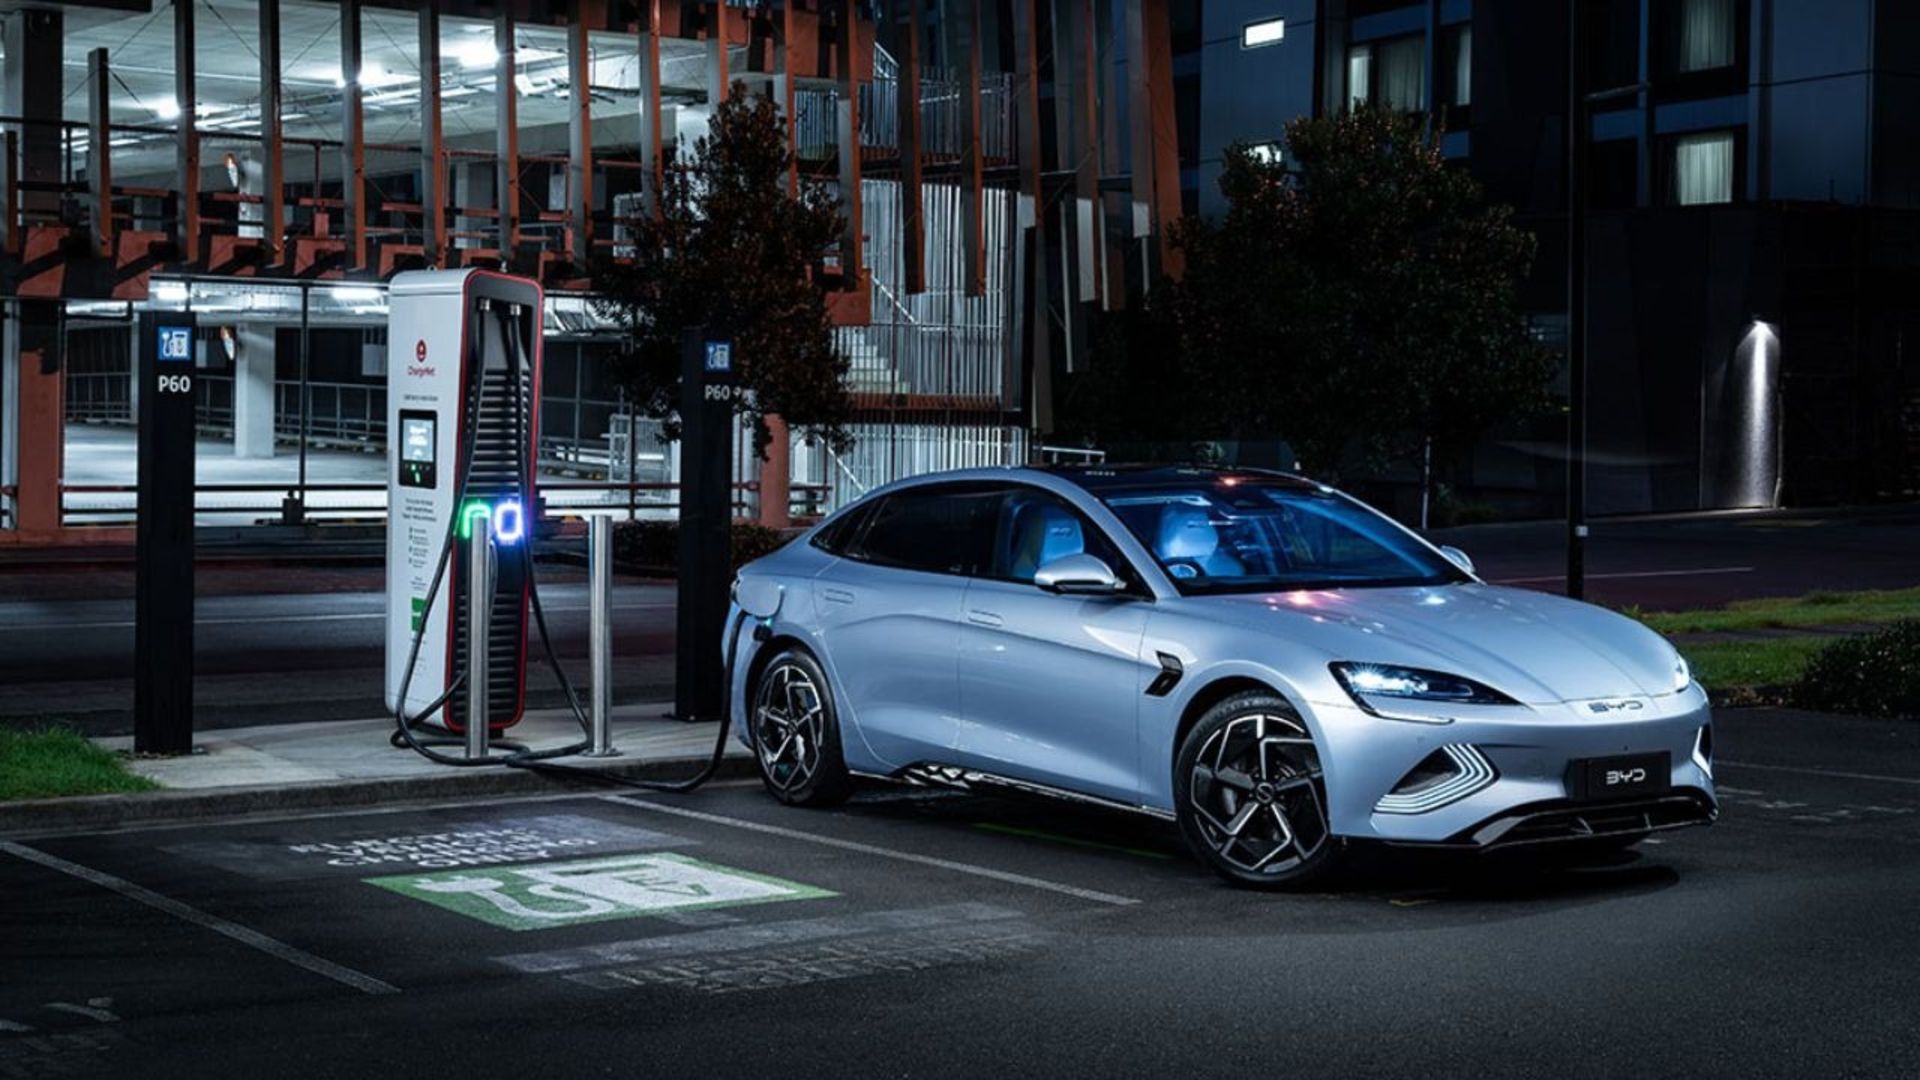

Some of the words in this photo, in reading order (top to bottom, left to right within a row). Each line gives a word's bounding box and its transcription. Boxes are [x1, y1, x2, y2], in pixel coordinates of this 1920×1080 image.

[158, 375, 191, 393] P60
[704, 384, 730, 400] P60
[1588, 700, 1643, 713] BYD
[1606, 768, 1646, 785] BYD
